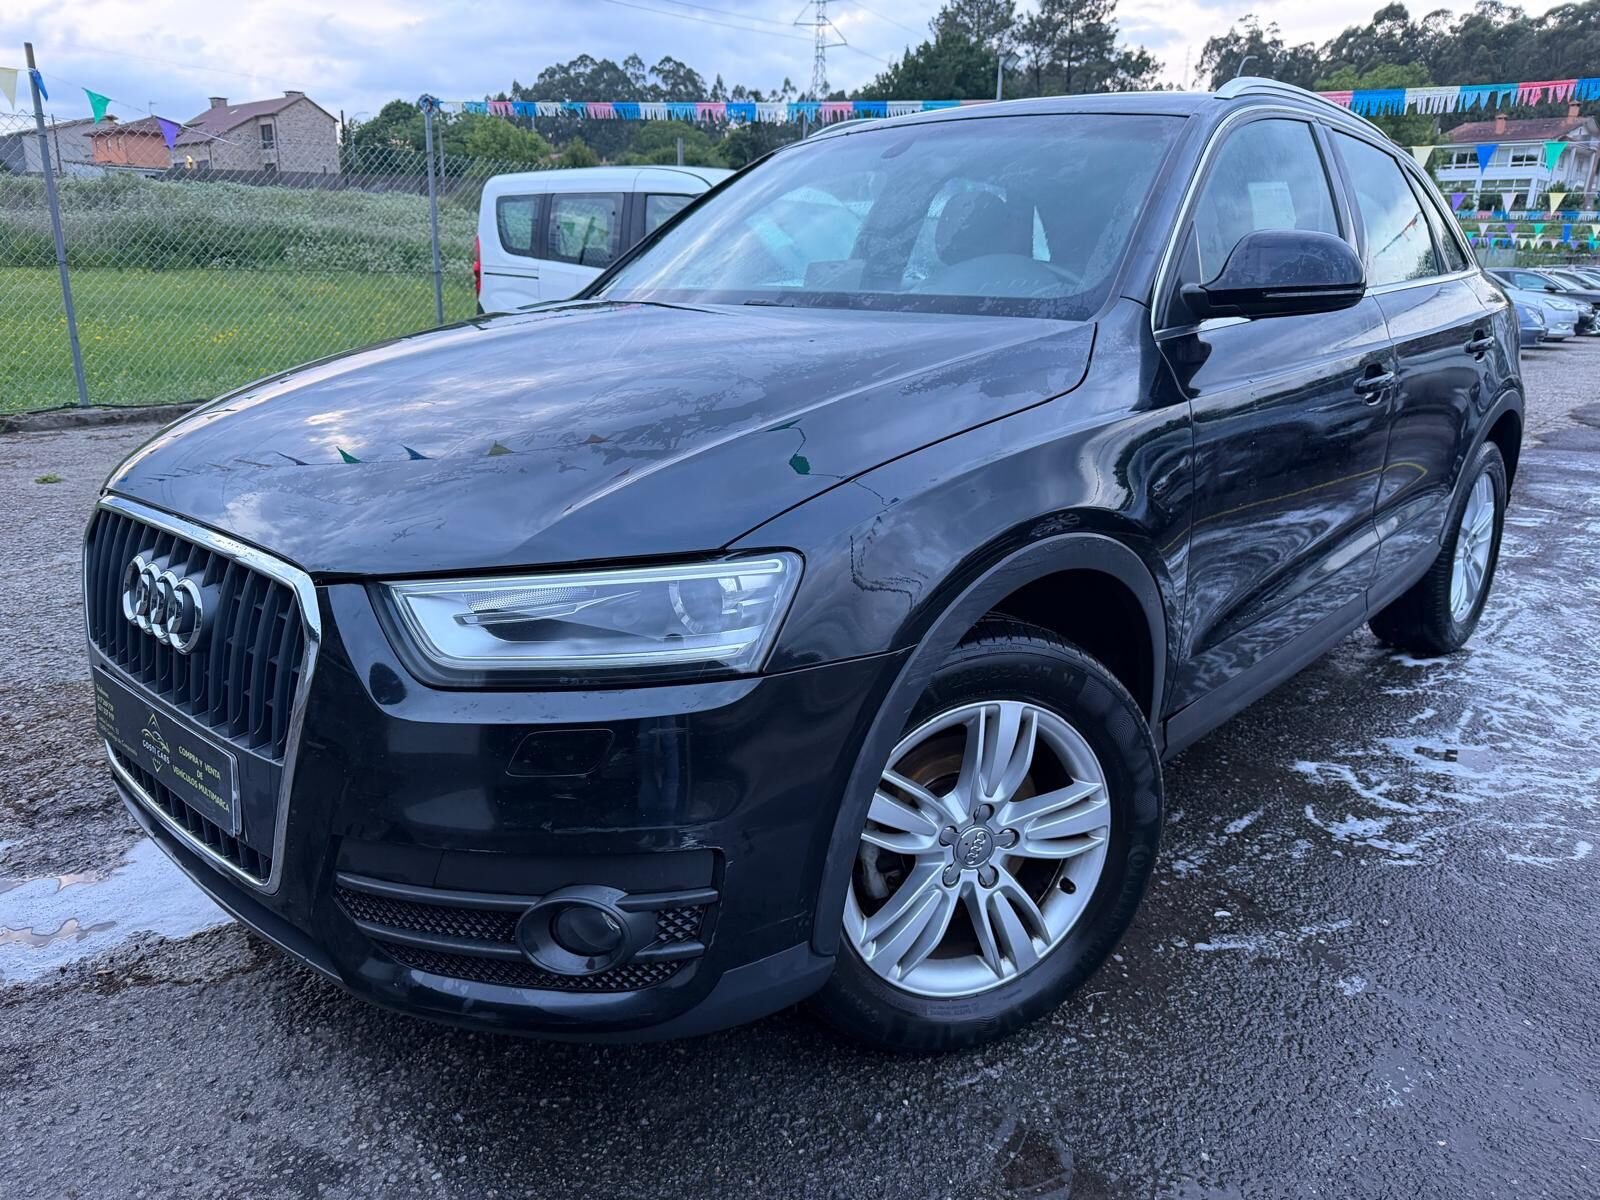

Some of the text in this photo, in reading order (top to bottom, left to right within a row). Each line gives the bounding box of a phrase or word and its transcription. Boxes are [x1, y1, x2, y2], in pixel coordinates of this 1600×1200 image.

[178, 745, 200, 767] COMPRA
[204, 762, 221, 780] VENTA
[196, 769, 204, 781] DE
[198, 782, 230, 813] MULTIMARCA
